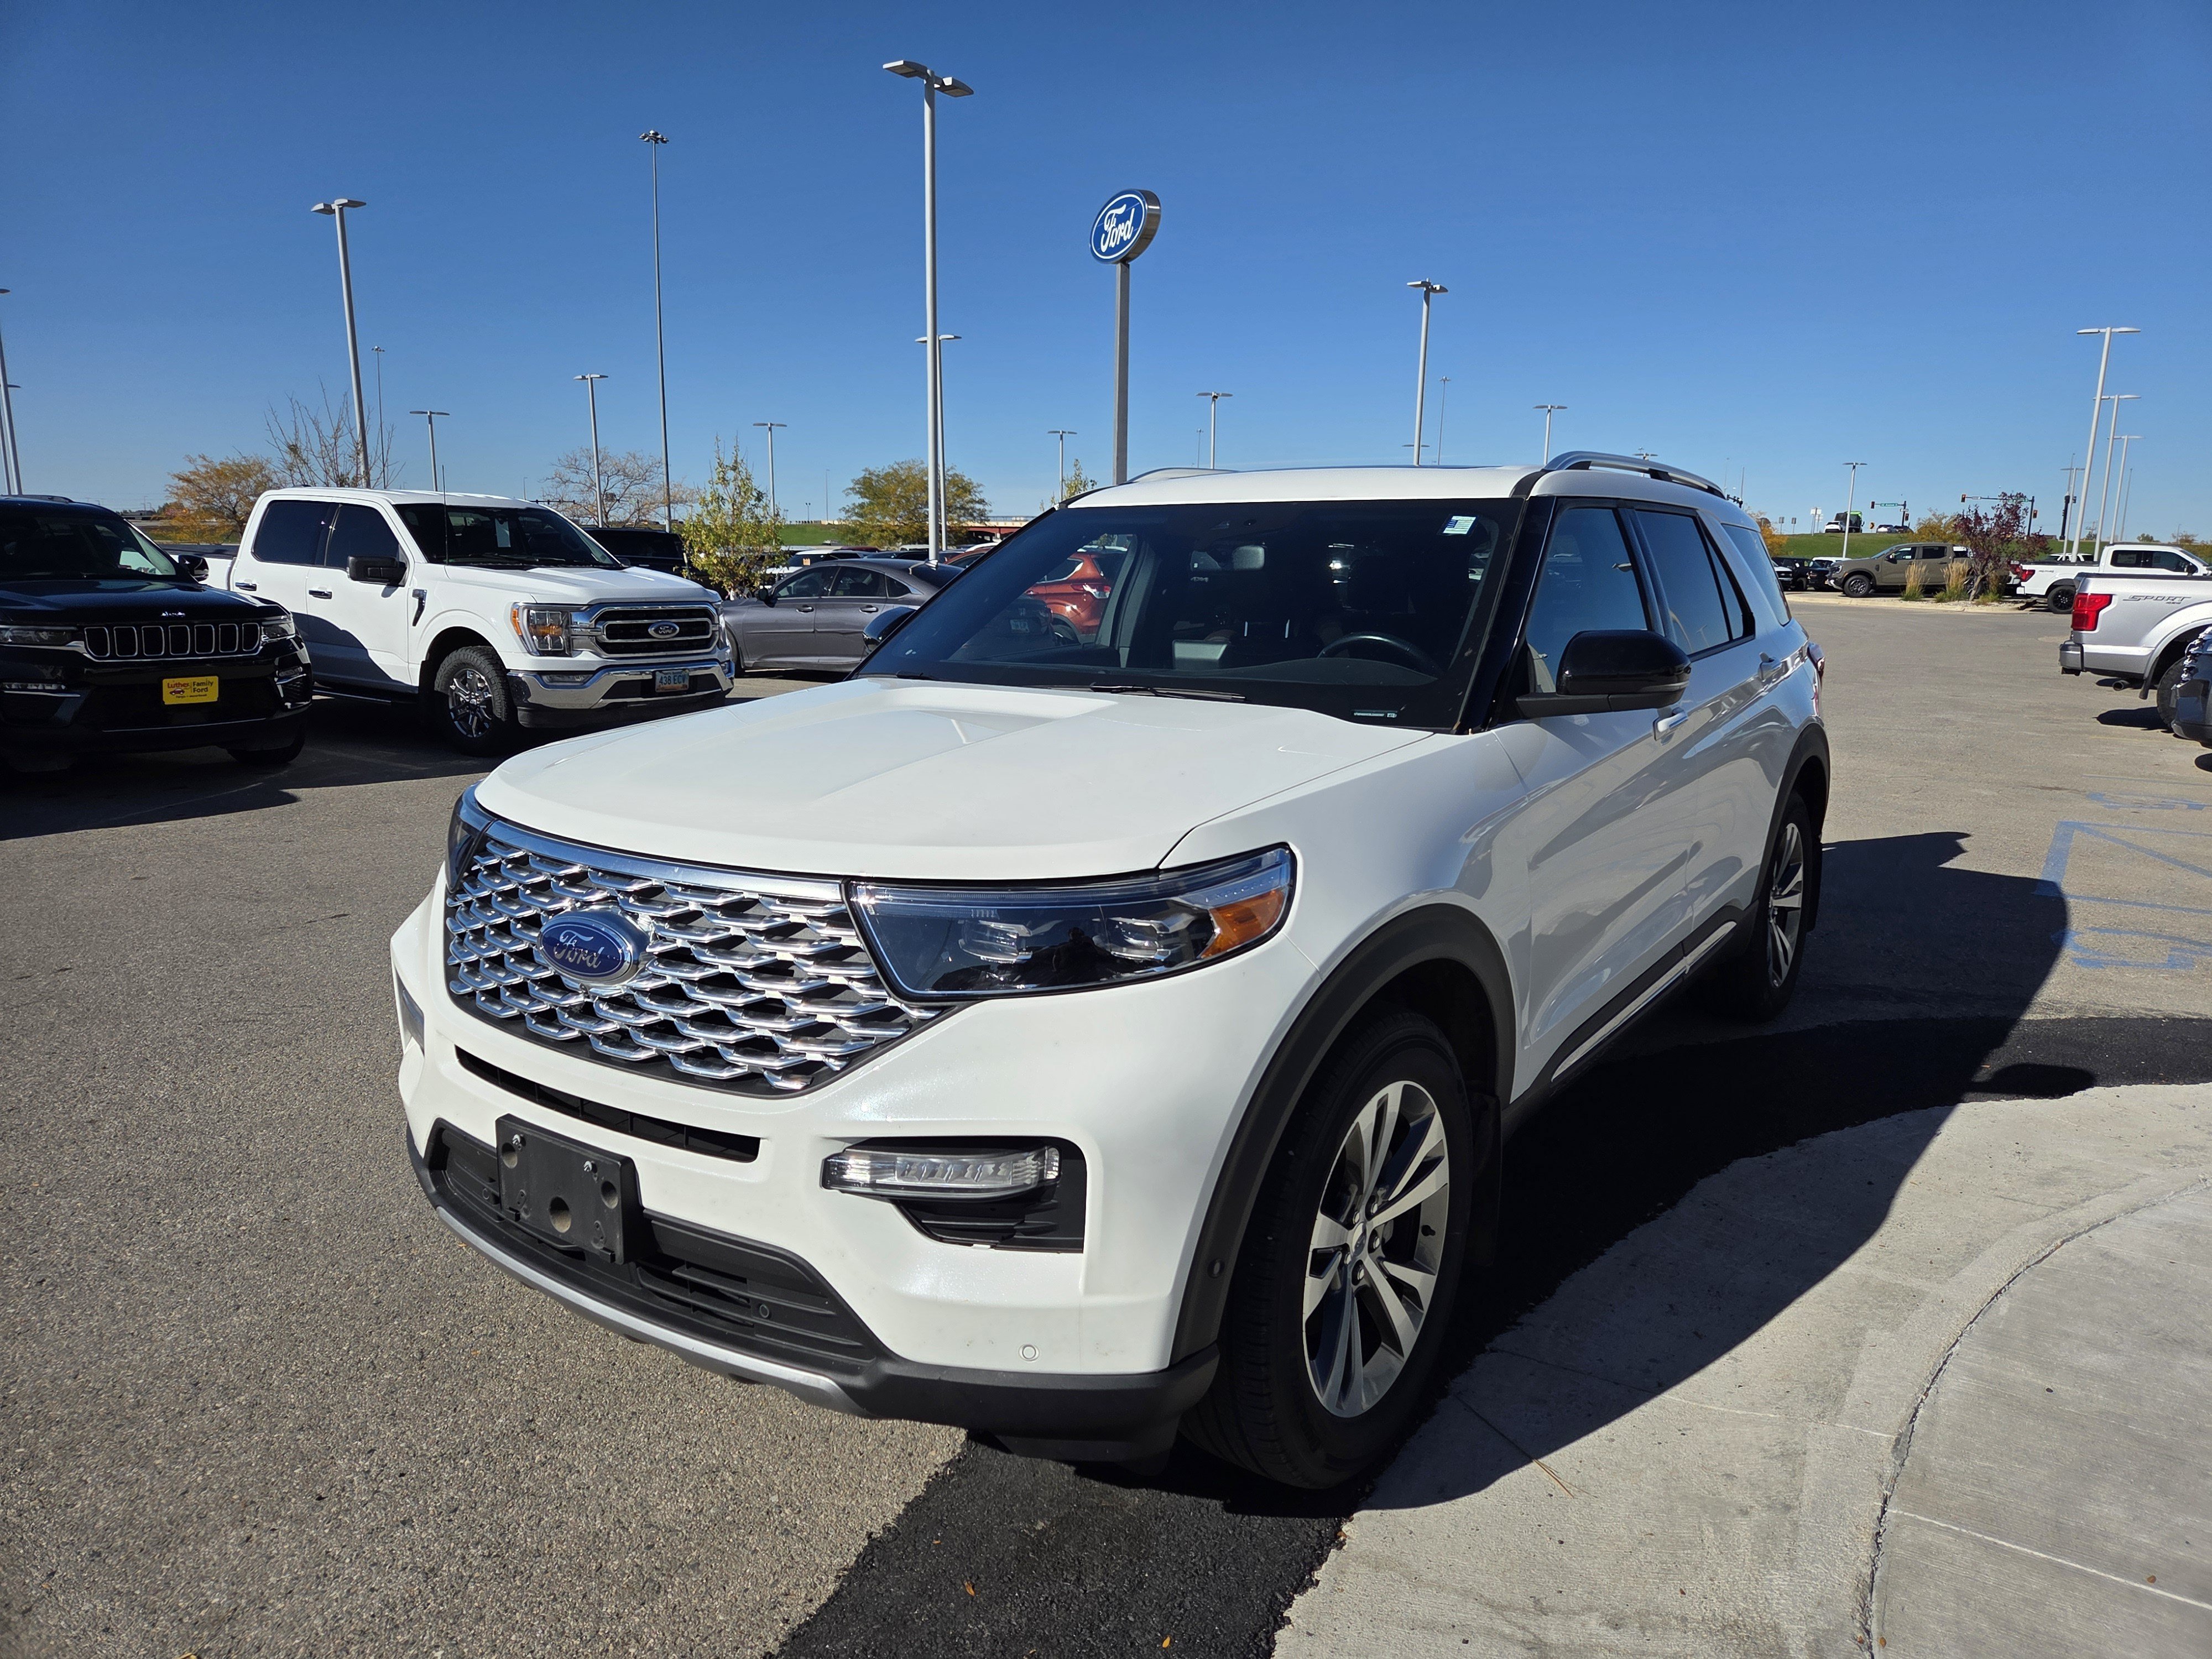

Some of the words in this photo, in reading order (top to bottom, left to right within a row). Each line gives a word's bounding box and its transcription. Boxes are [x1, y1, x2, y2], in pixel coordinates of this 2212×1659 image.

[1100, 204, 1135, 252] Ford
[192, 679, 213, 687] Family
[554, 930, 605, 968] Ford
